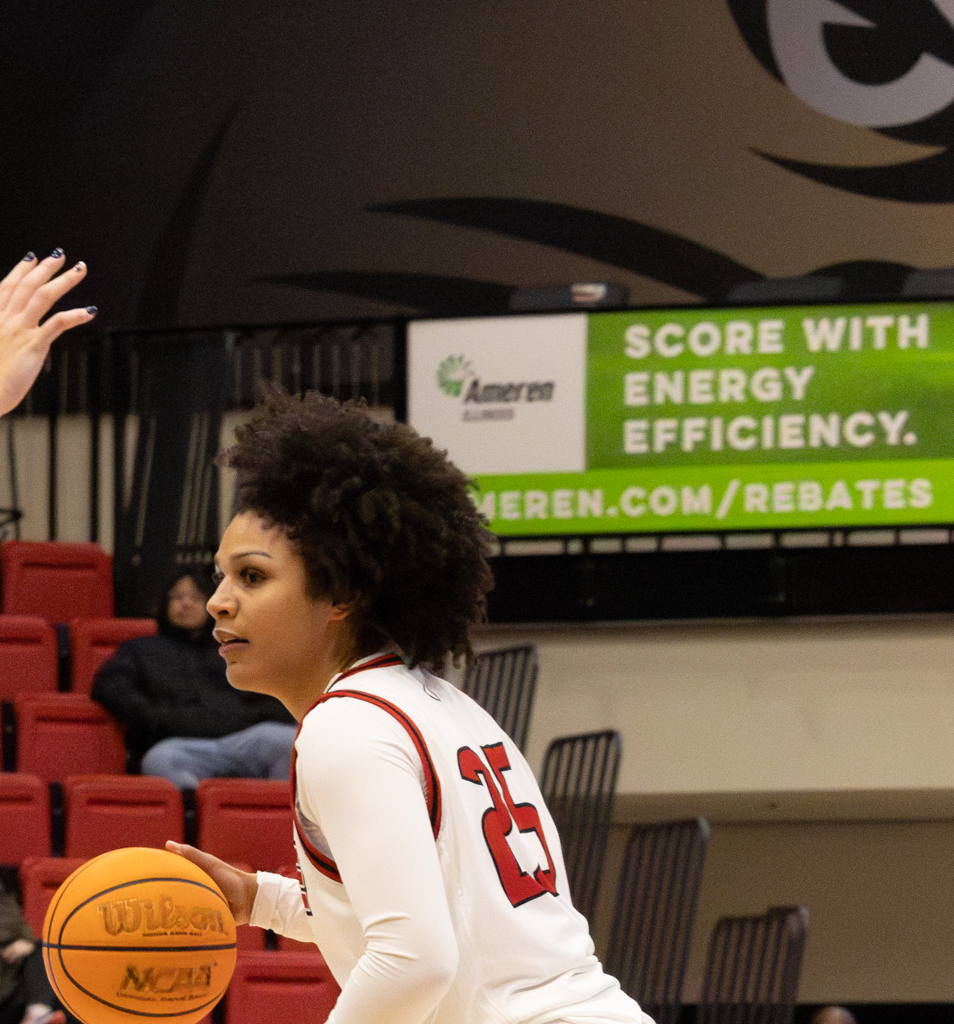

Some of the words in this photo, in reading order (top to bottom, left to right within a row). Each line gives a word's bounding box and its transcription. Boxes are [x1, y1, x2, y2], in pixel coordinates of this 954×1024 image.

[624, 319, 785, 359] SCORE
[802, 314, 929, 352] WITH
[464, 378, 555, 404] Ameren
[623, 365, 815, 406] ENERGY
[623, 410, 917, 455] EFFICIENCY.
[457, 741, 560, 909] 25
[119, 964, 212, 994] NCAA
